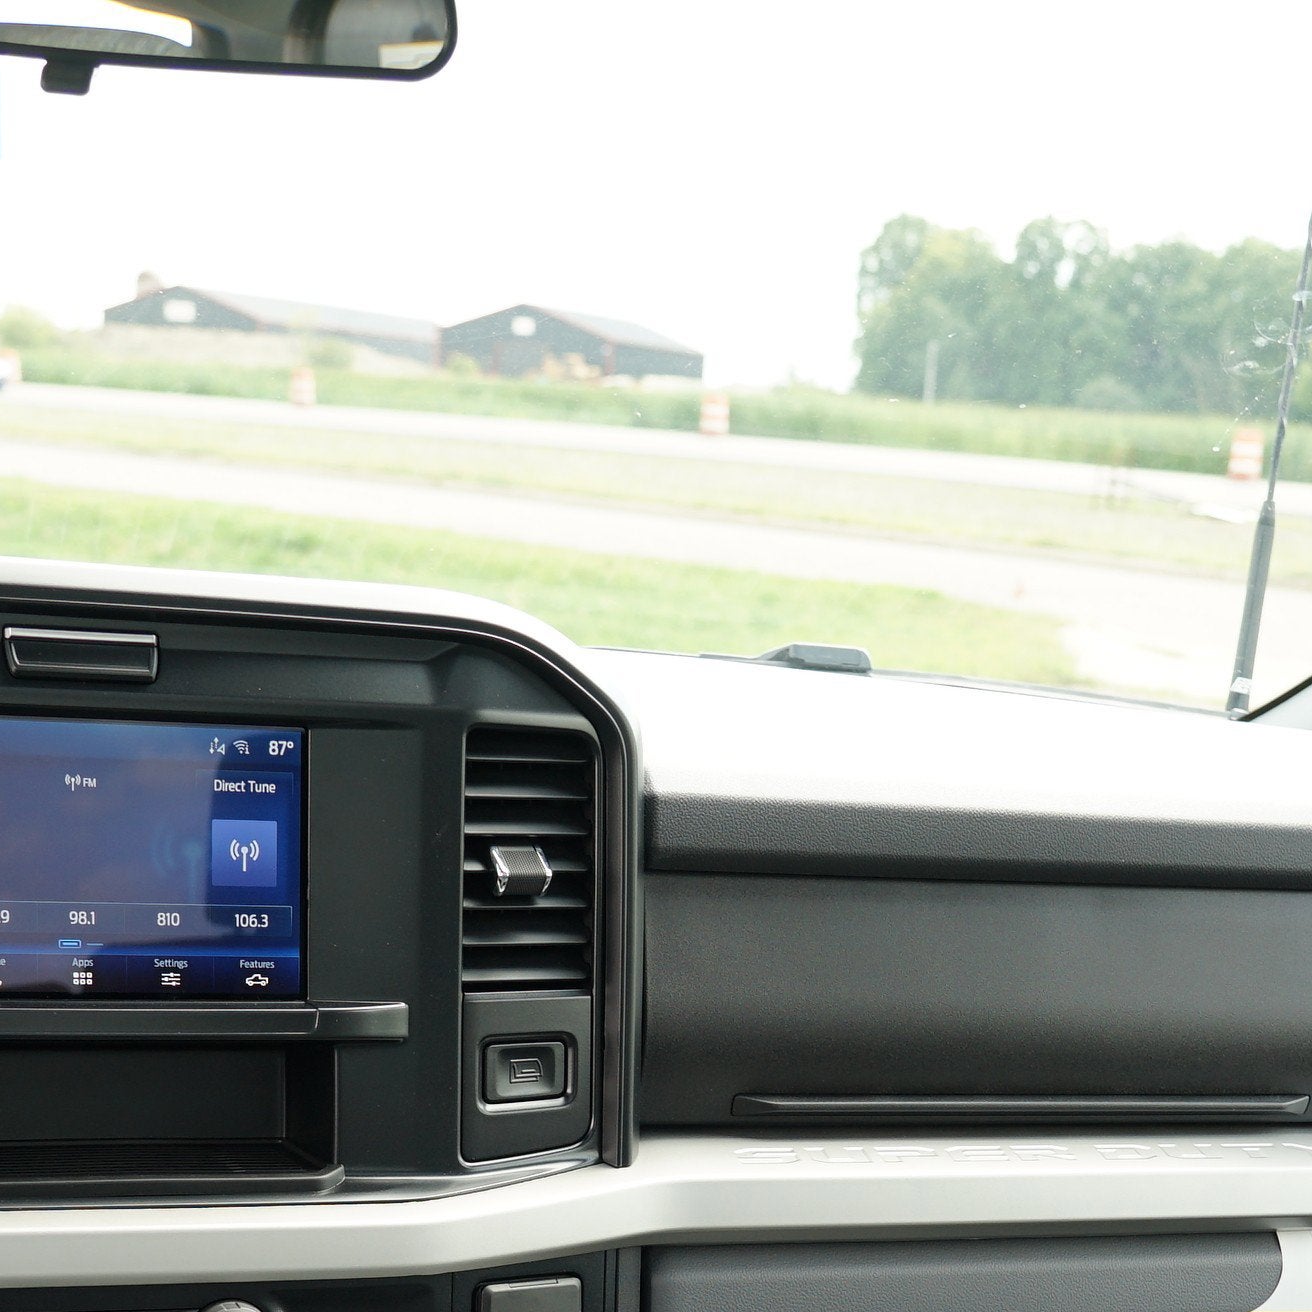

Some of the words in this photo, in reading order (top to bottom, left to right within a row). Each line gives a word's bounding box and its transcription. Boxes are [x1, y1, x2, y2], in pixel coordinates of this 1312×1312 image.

[268, 740, 295, 756] 87°
[83, 778, 97, 788] FM
[213, 779, 245, 793] Direct
[247, 781, 276, 794] Tune
[69, 911, 96, 926] 98.1
[157, 912, 181, 927] 810
[234, 913, 269, 928] 106.3
[72, 957, 94, 969] Apps
[153, 958, 189, 970] Settings
[239, 959, 276, 970] Features
[733, 1143, 1079, 1165] SUPER
